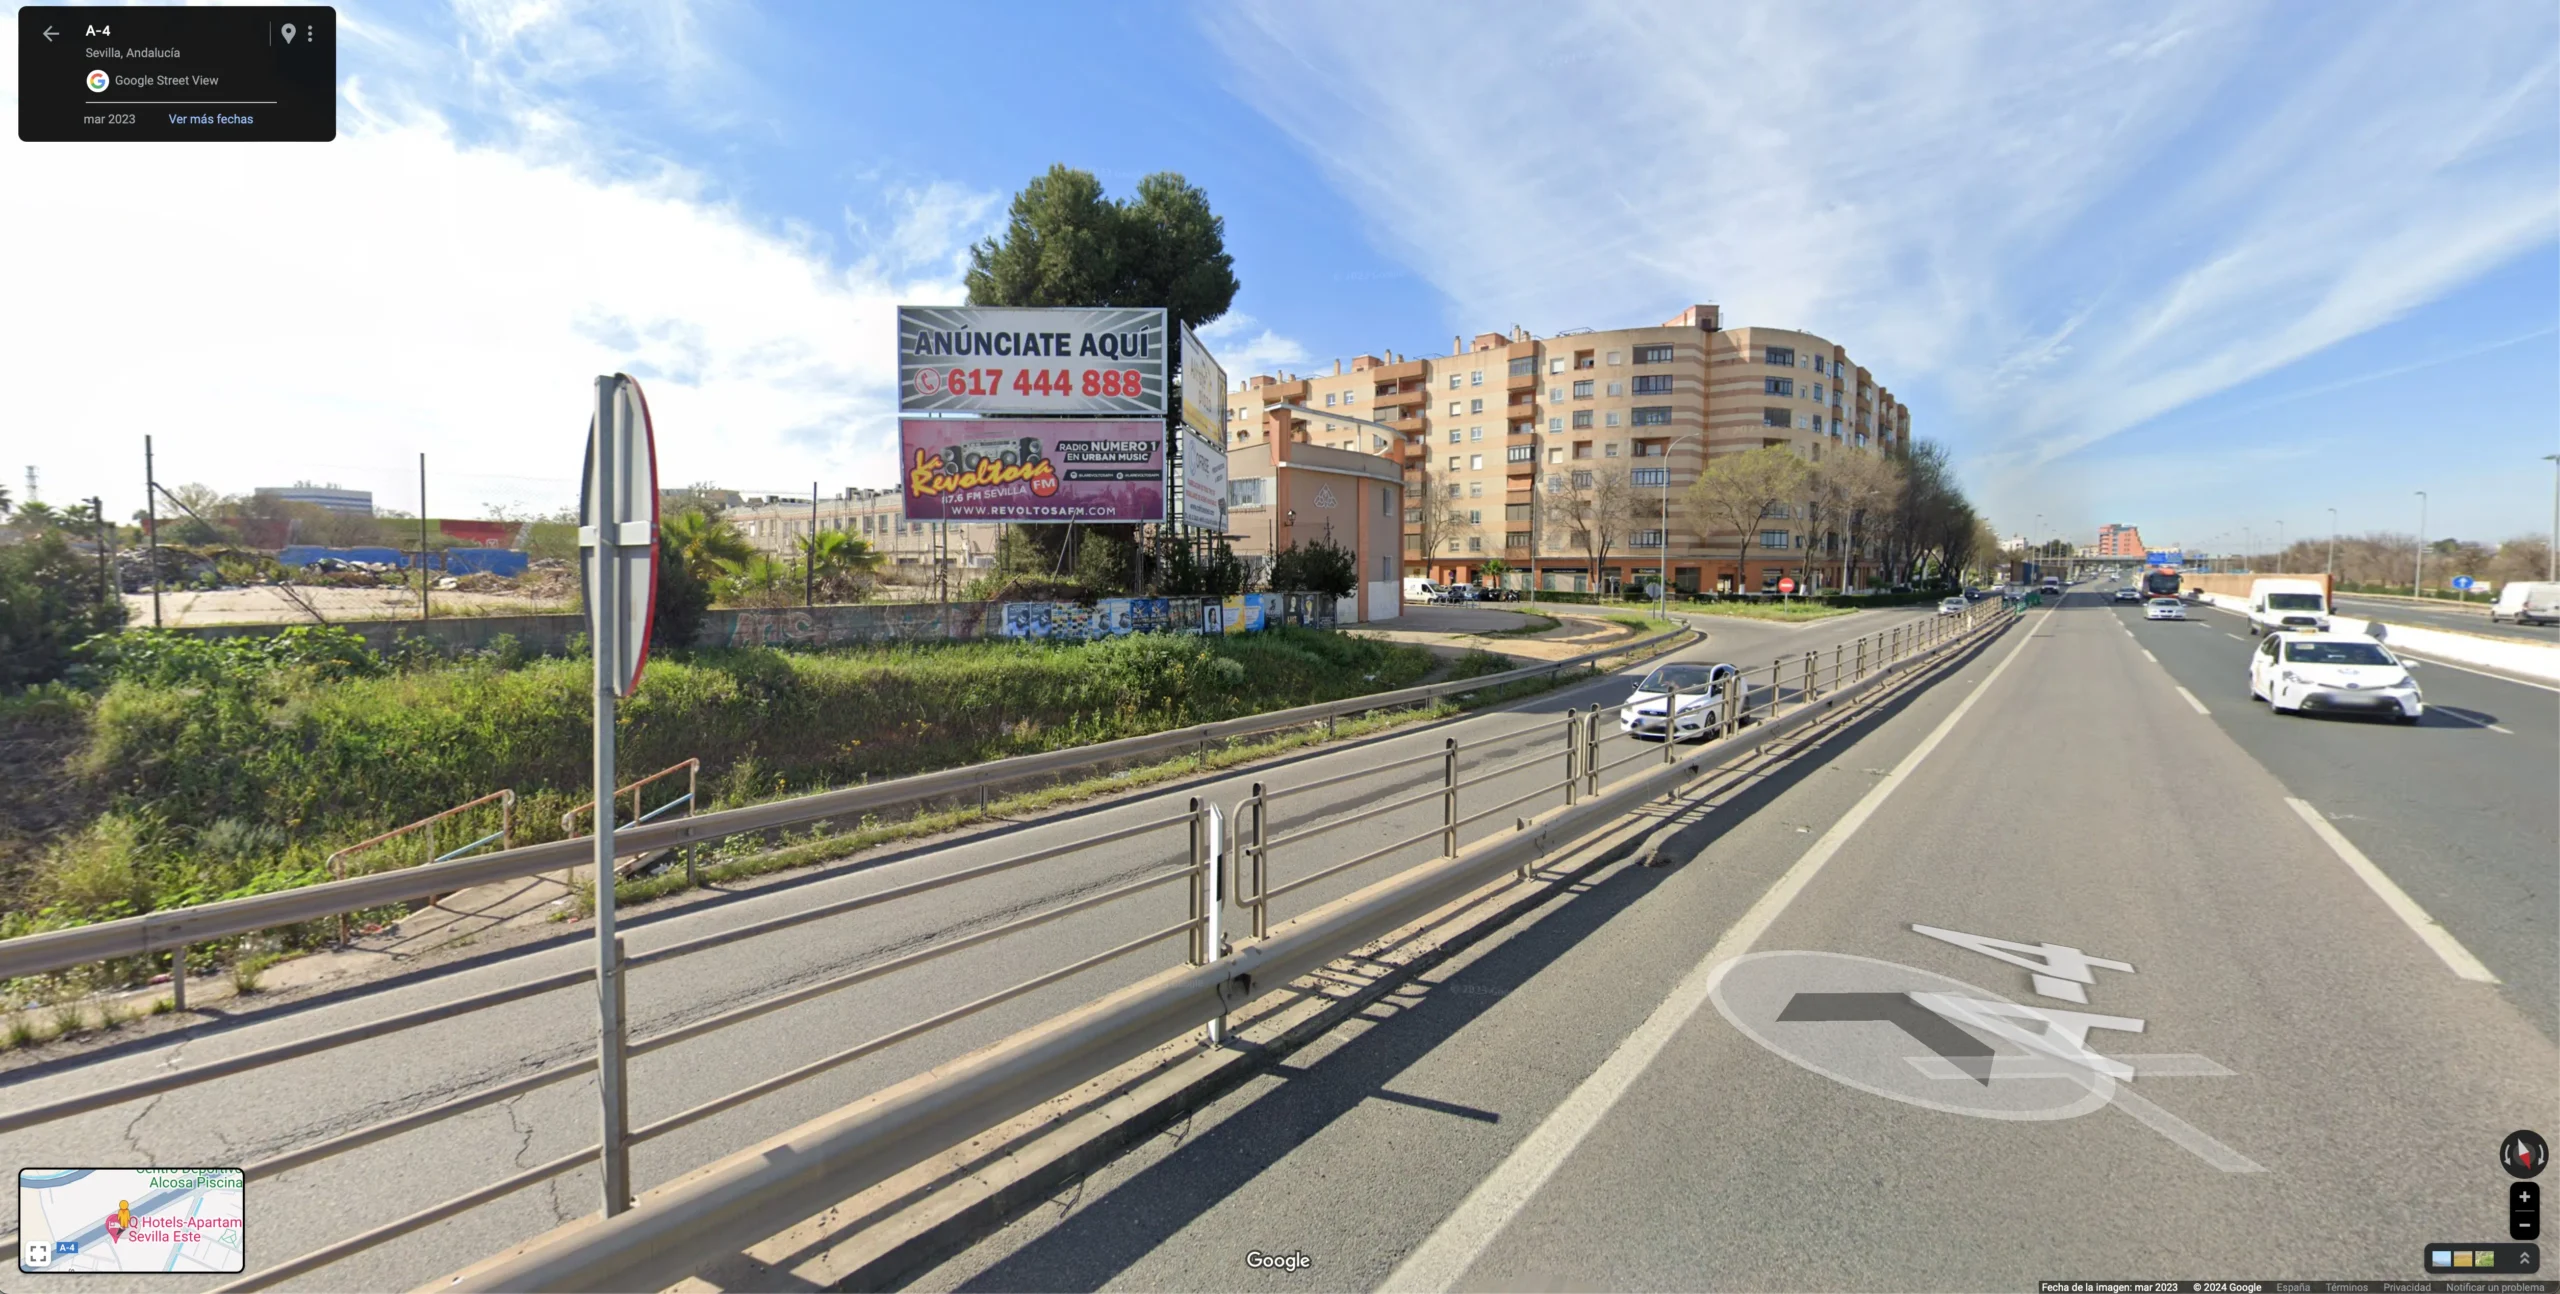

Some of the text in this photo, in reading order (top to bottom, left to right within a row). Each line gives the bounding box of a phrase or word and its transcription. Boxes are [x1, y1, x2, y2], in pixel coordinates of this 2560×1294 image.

[914, 324, 1071, 357] ANÚNCIATE
[1079, 325, 1149, 361] AQUÍ
[948, 367, 1142, 398] 617 444 888
[1059, 439, 1156, 451] RADIO NÚMERO 1
[1067, 453, 1149, 461] EN URBAN MUSIC
[910, 456, 1054, 498] Revoltosa
[1032, 477, 1056, 491] FM
[966, 491, 982, 501] FM
[983, 485, 1028, 499] SEVILLA
[951, 506, 1116, 516] WWW.REVOLTOSAFM.COM
